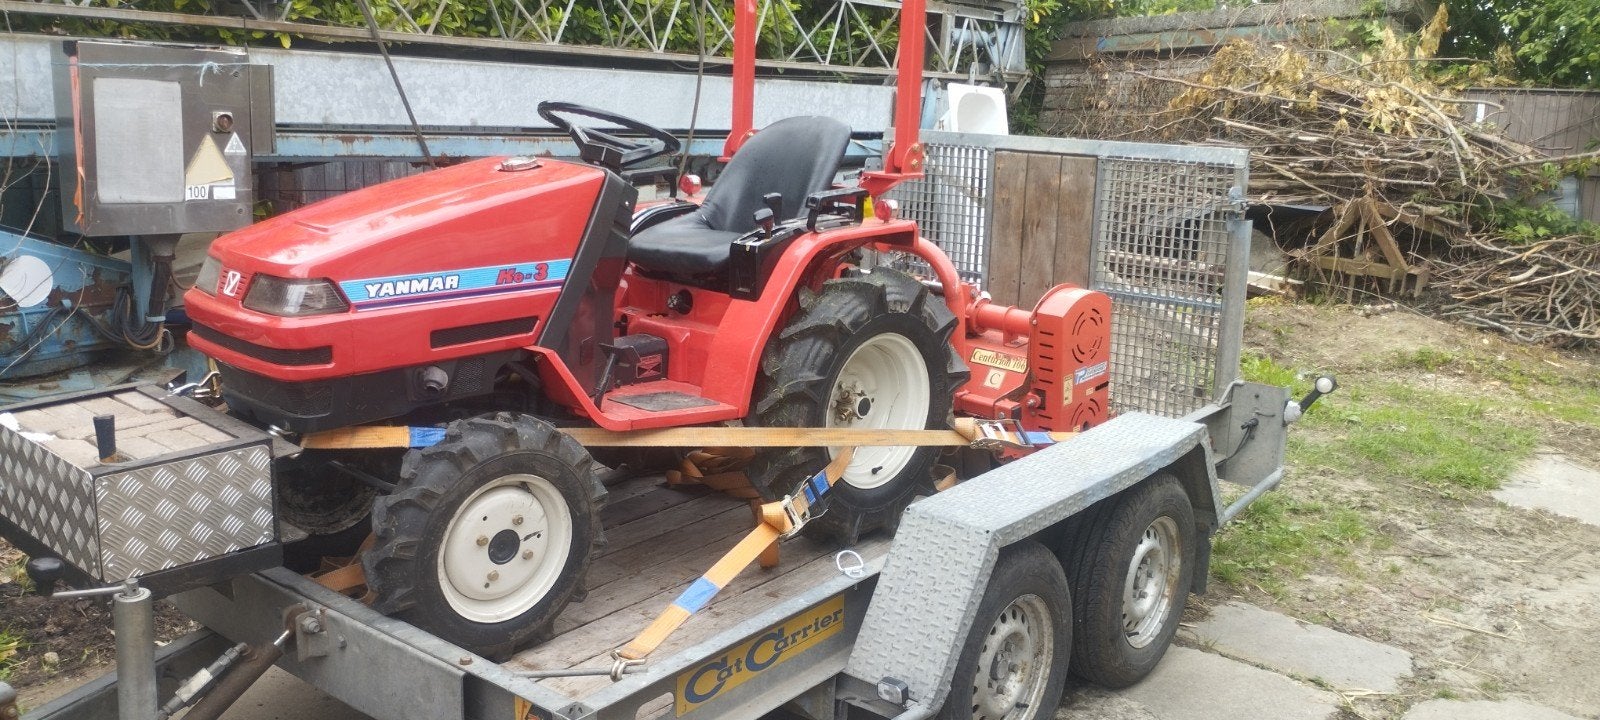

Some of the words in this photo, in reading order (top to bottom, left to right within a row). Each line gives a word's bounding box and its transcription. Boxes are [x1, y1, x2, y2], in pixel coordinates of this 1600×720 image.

[188, 186, 206, 198] 100
[365, 275, 459, 298] YANMAR
[990, 372, 1001, 386] C
[684, 656, 743, 703] Cat
[745, 608, 843, 672] Carrier
